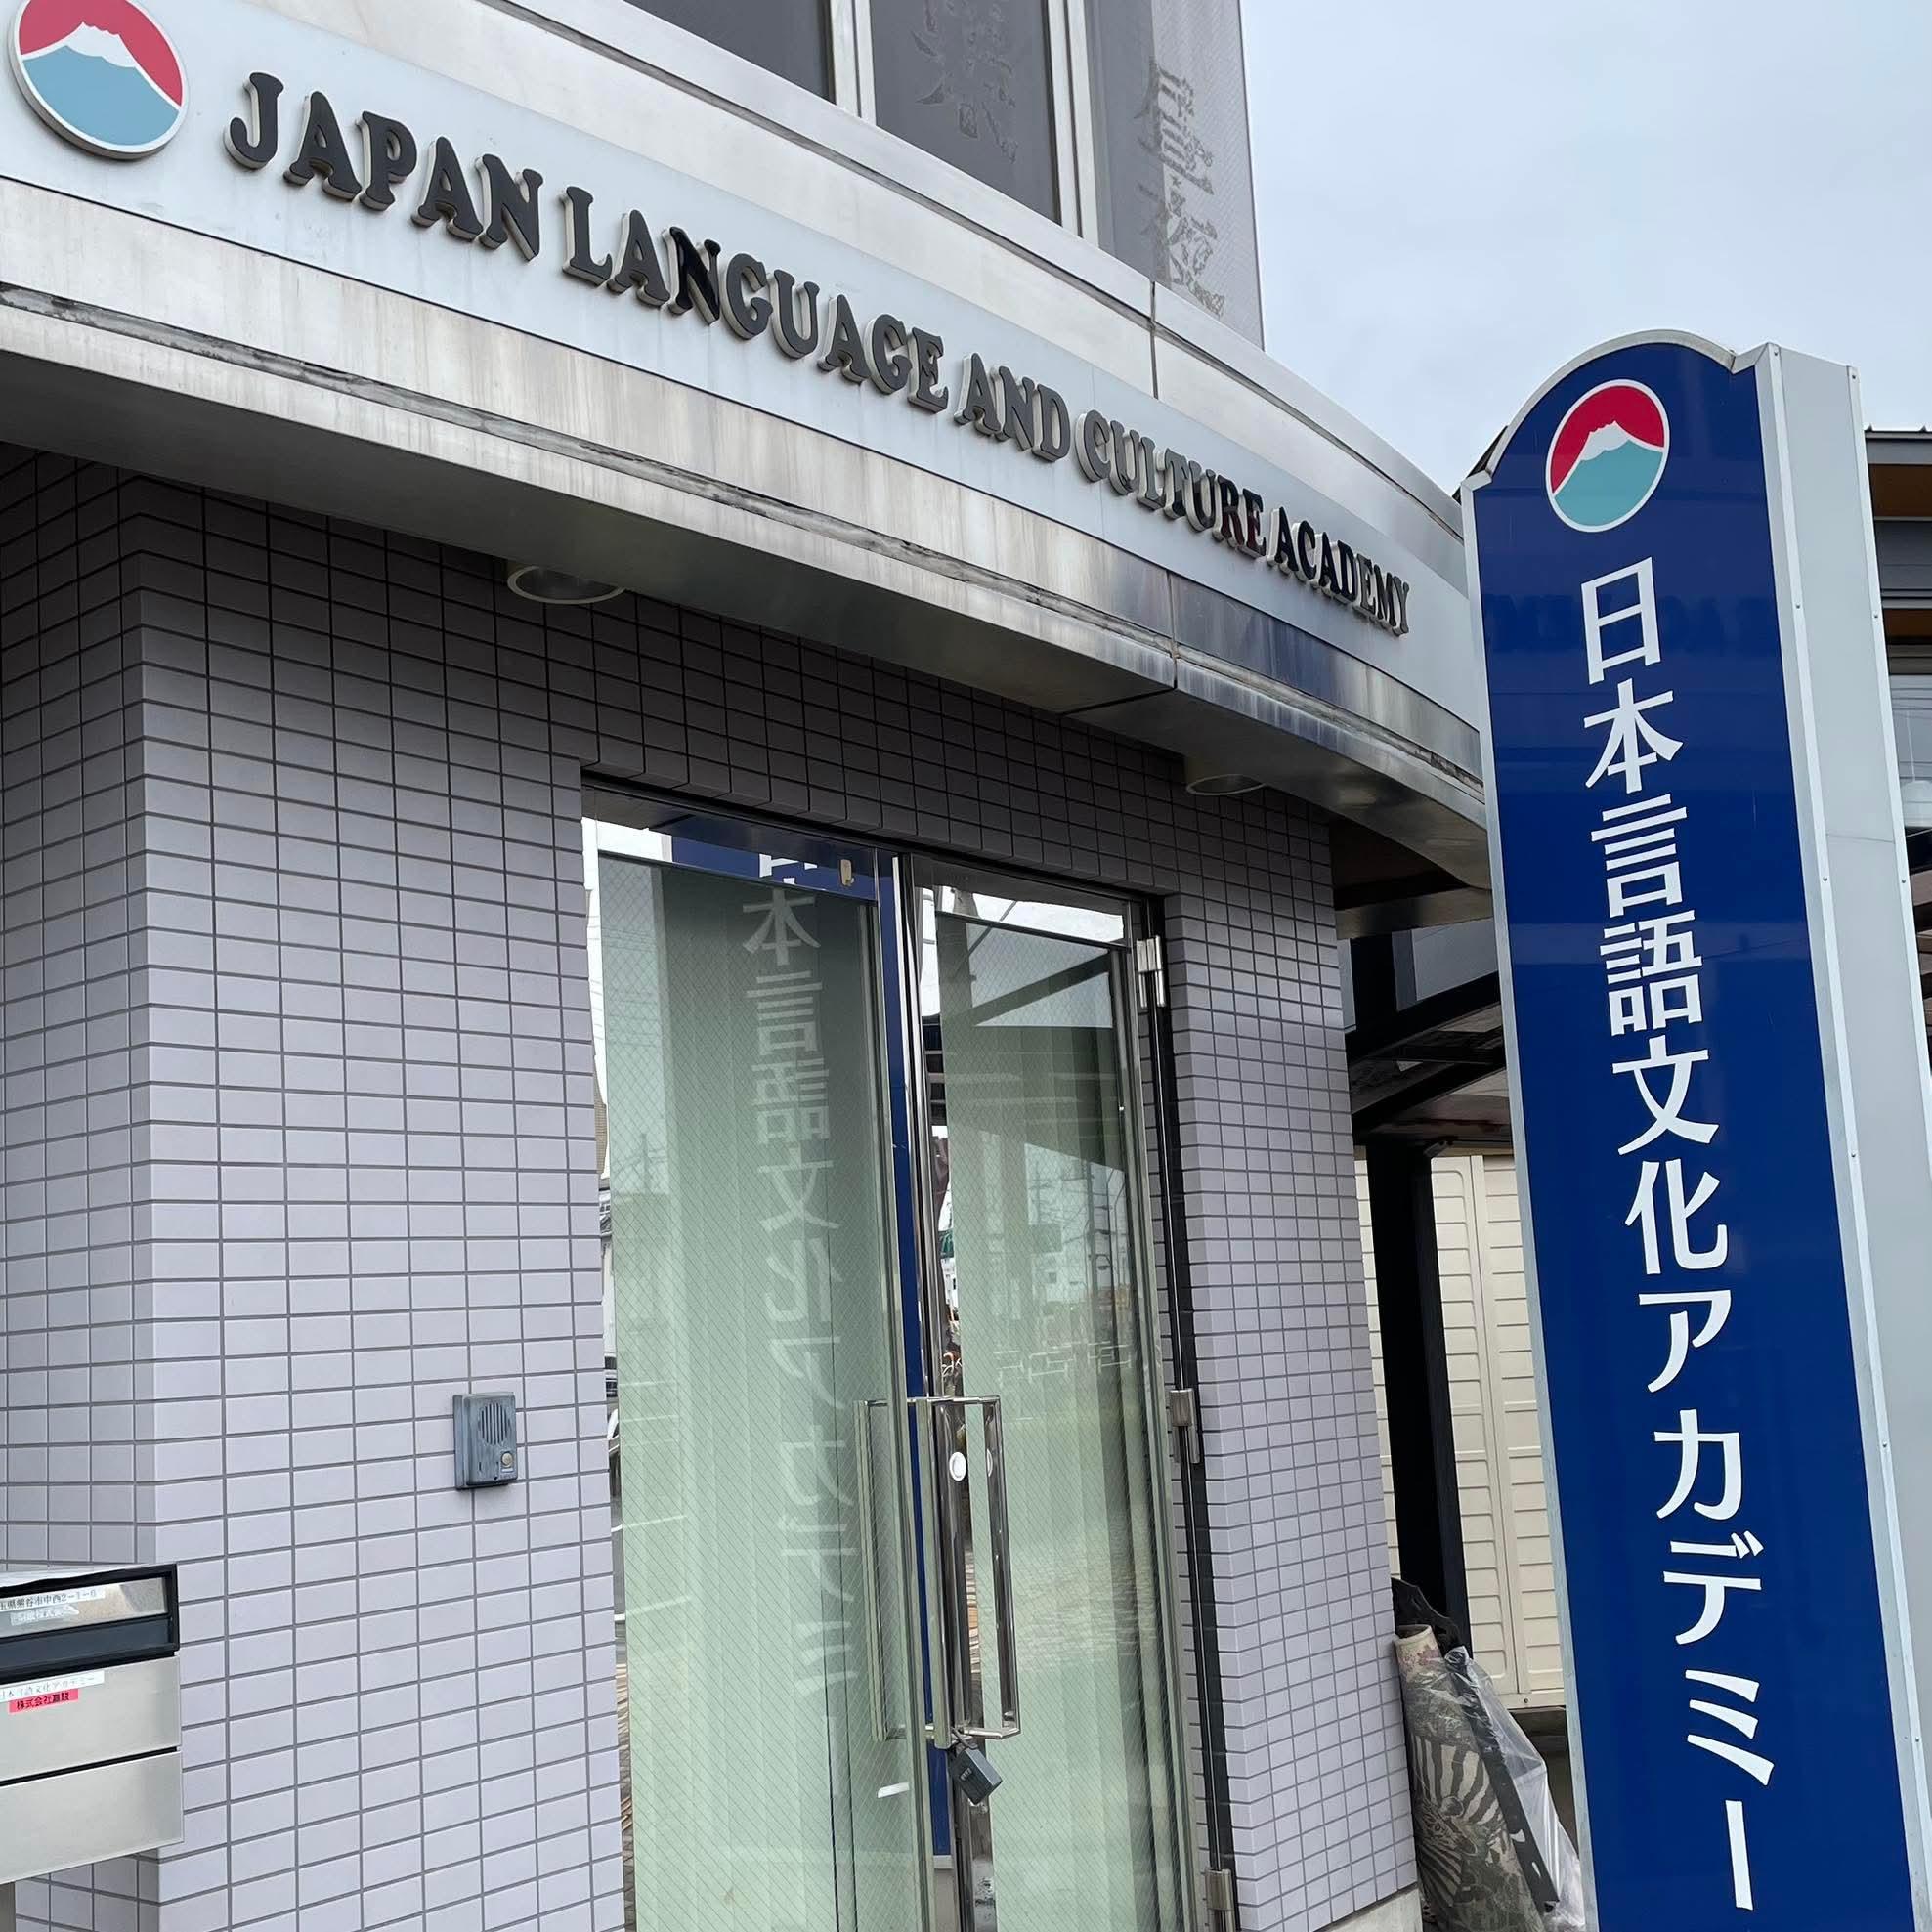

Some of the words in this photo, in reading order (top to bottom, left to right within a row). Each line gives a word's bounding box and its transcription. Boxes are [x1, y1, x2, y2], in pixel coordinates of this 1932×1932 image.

[225, 71, 543, 261] JAPAN
[558, 186, 949, 412] LANGUAGE
[954, 353, 1071, 462] AND
[1075, 409, 1267, 559] CULTURE
[1267, 506, 1410, 636] ACADEMY
[1580, 556, 1775, 1911] 日本言語文化アカデミー
